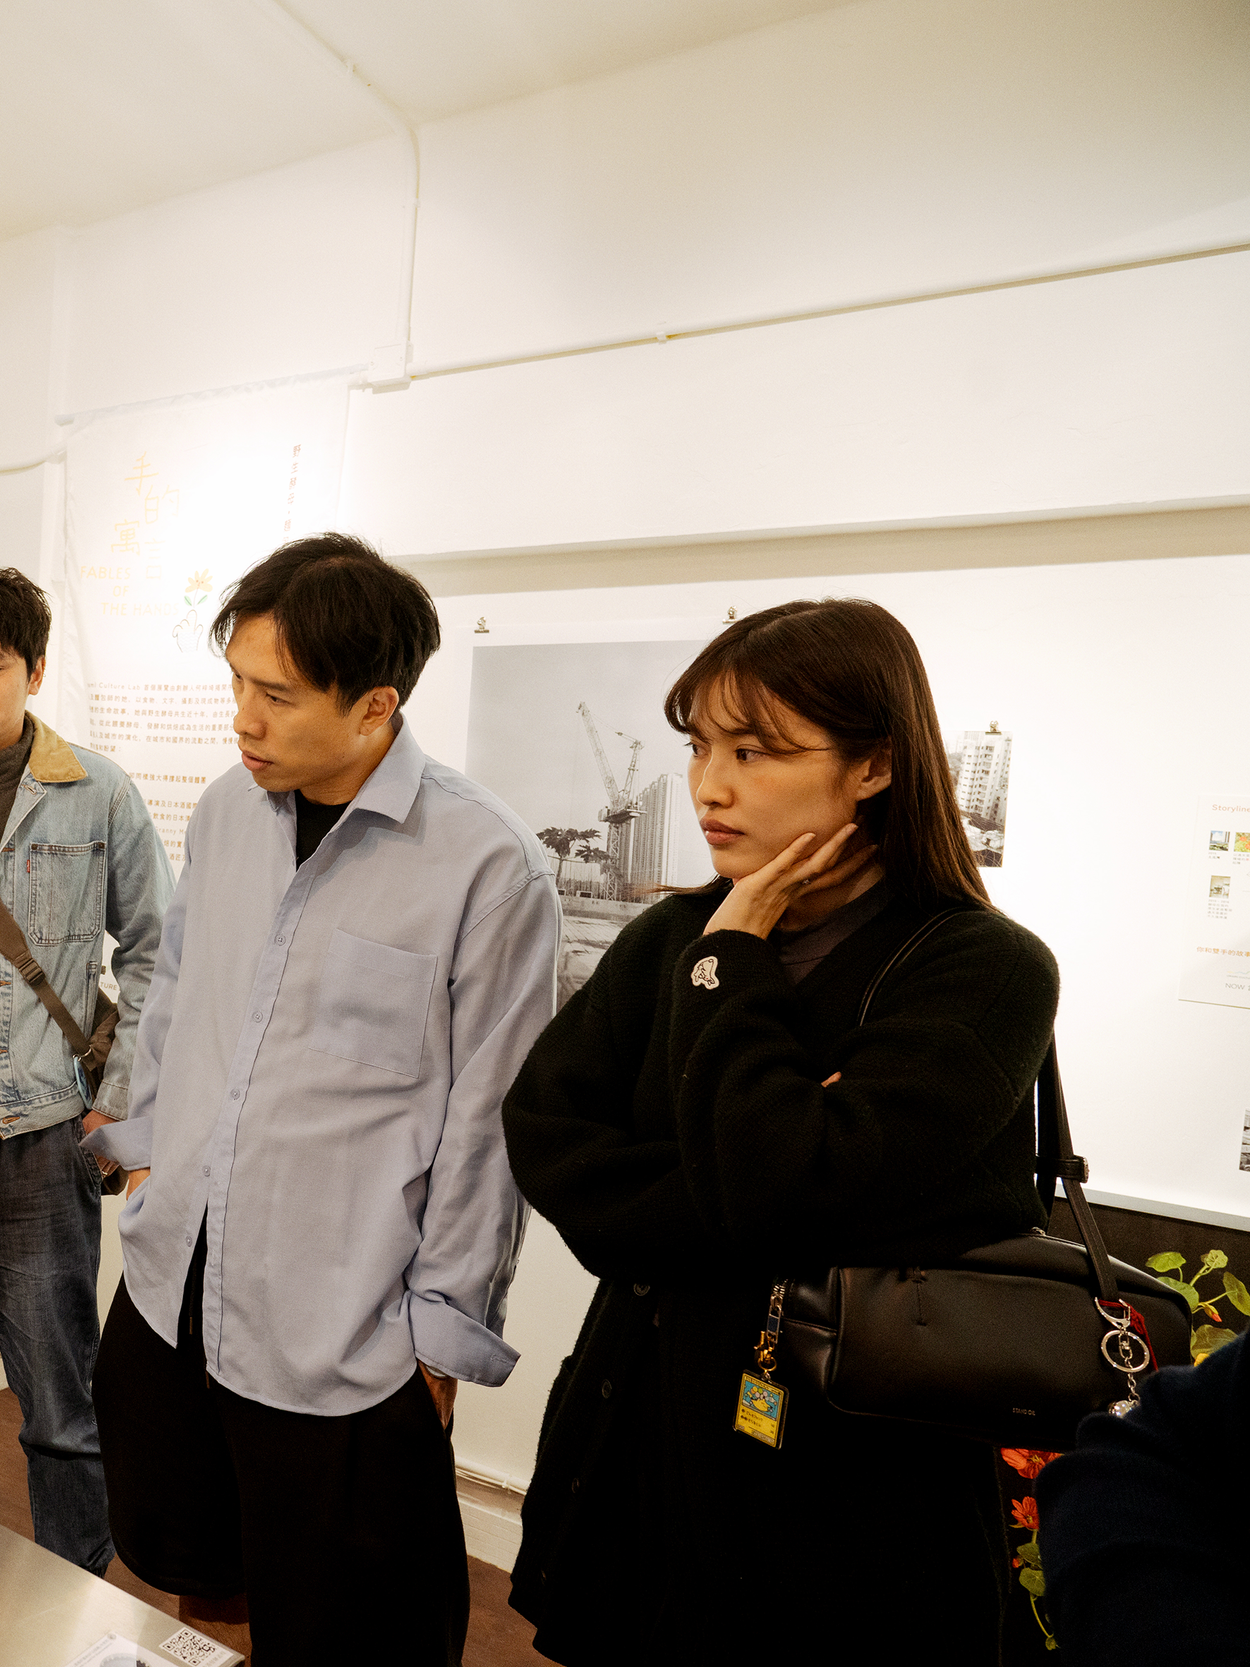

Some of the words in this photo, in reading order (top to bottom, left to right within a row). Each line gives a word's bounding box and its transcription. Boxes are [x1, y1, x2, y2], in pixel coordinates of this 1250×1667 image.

[80, 566, 131, 580] FABLES
[112, 585, 130, 598] OF
[101, 602, 127, 616] THE
[132, 602, 179, 617] HANDS
[99, 682, 125, 690] Culture
[1212, 804, 1250, 814] Storyline
[1225, 983, 1246, 991] NOW
